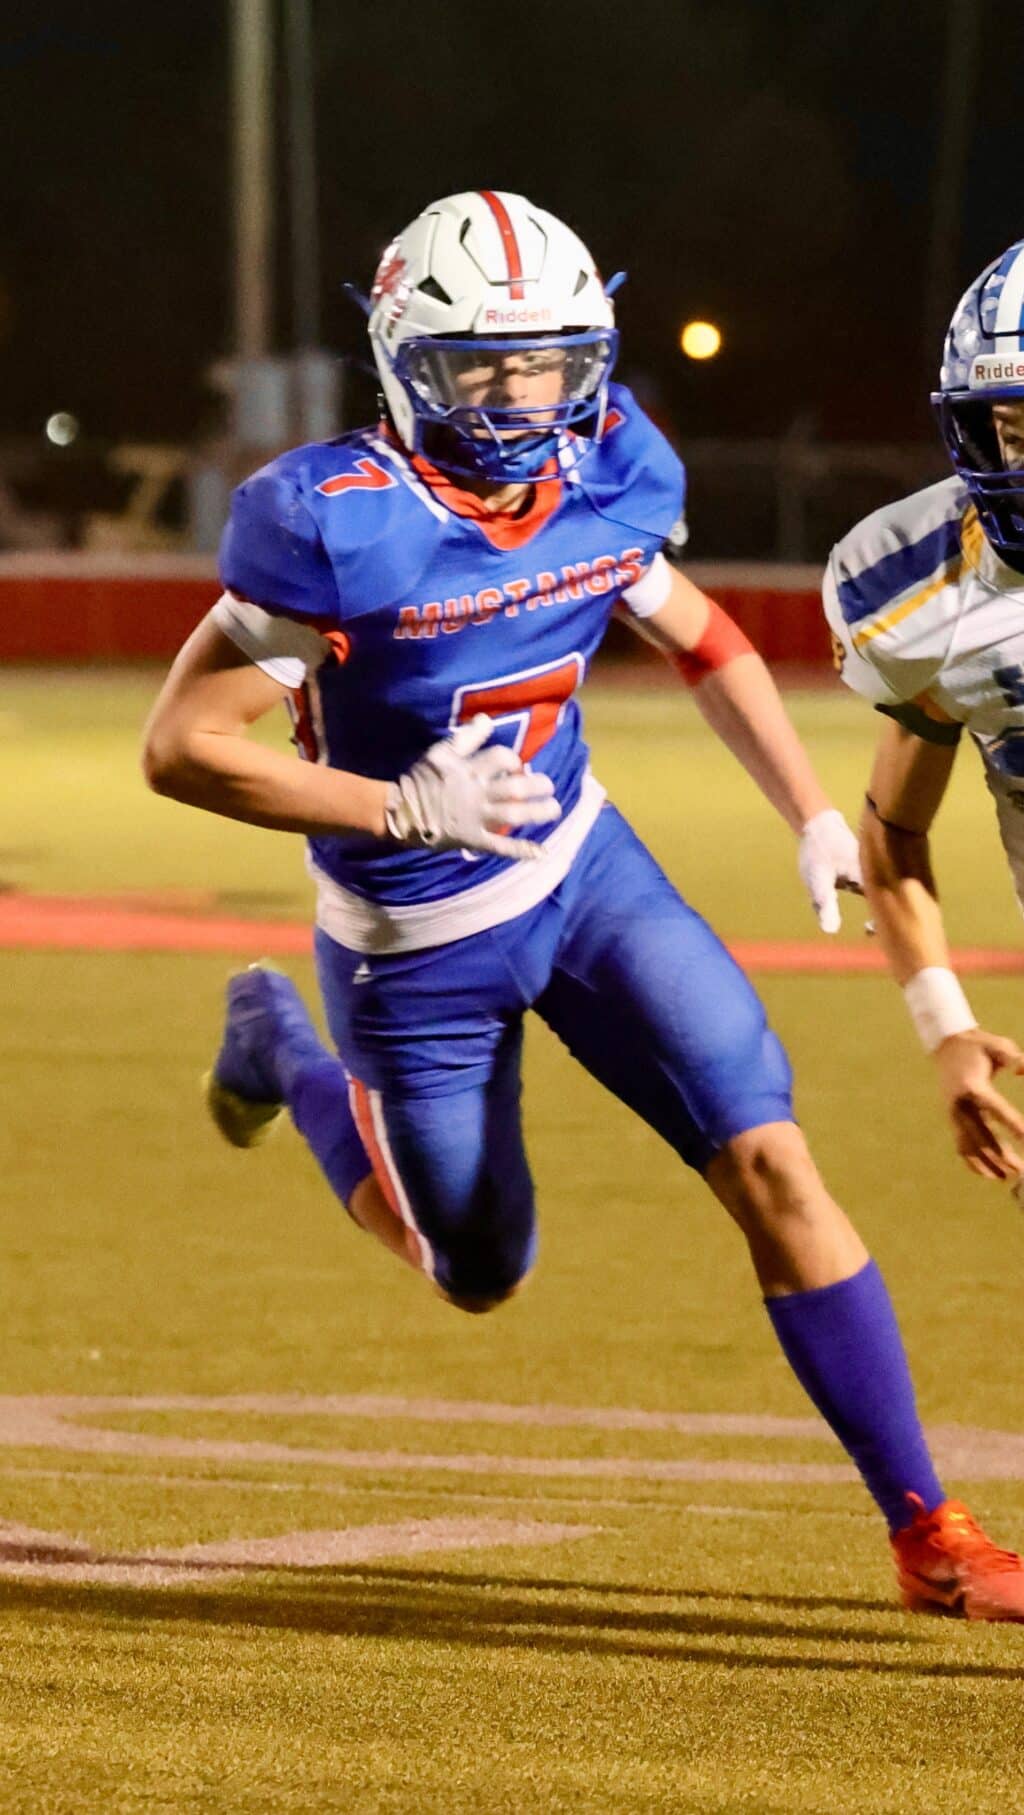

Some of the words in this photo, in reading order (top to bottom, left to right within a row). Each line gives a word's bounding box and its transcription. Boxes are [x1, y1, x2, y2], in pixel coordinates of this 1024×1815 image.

[486, 308, 551, 324] Riddell
[313, 457, 399, 497] 7
[393, 547, 645, 639] MUSTANGS
[448, 651, 586, 795] 7
